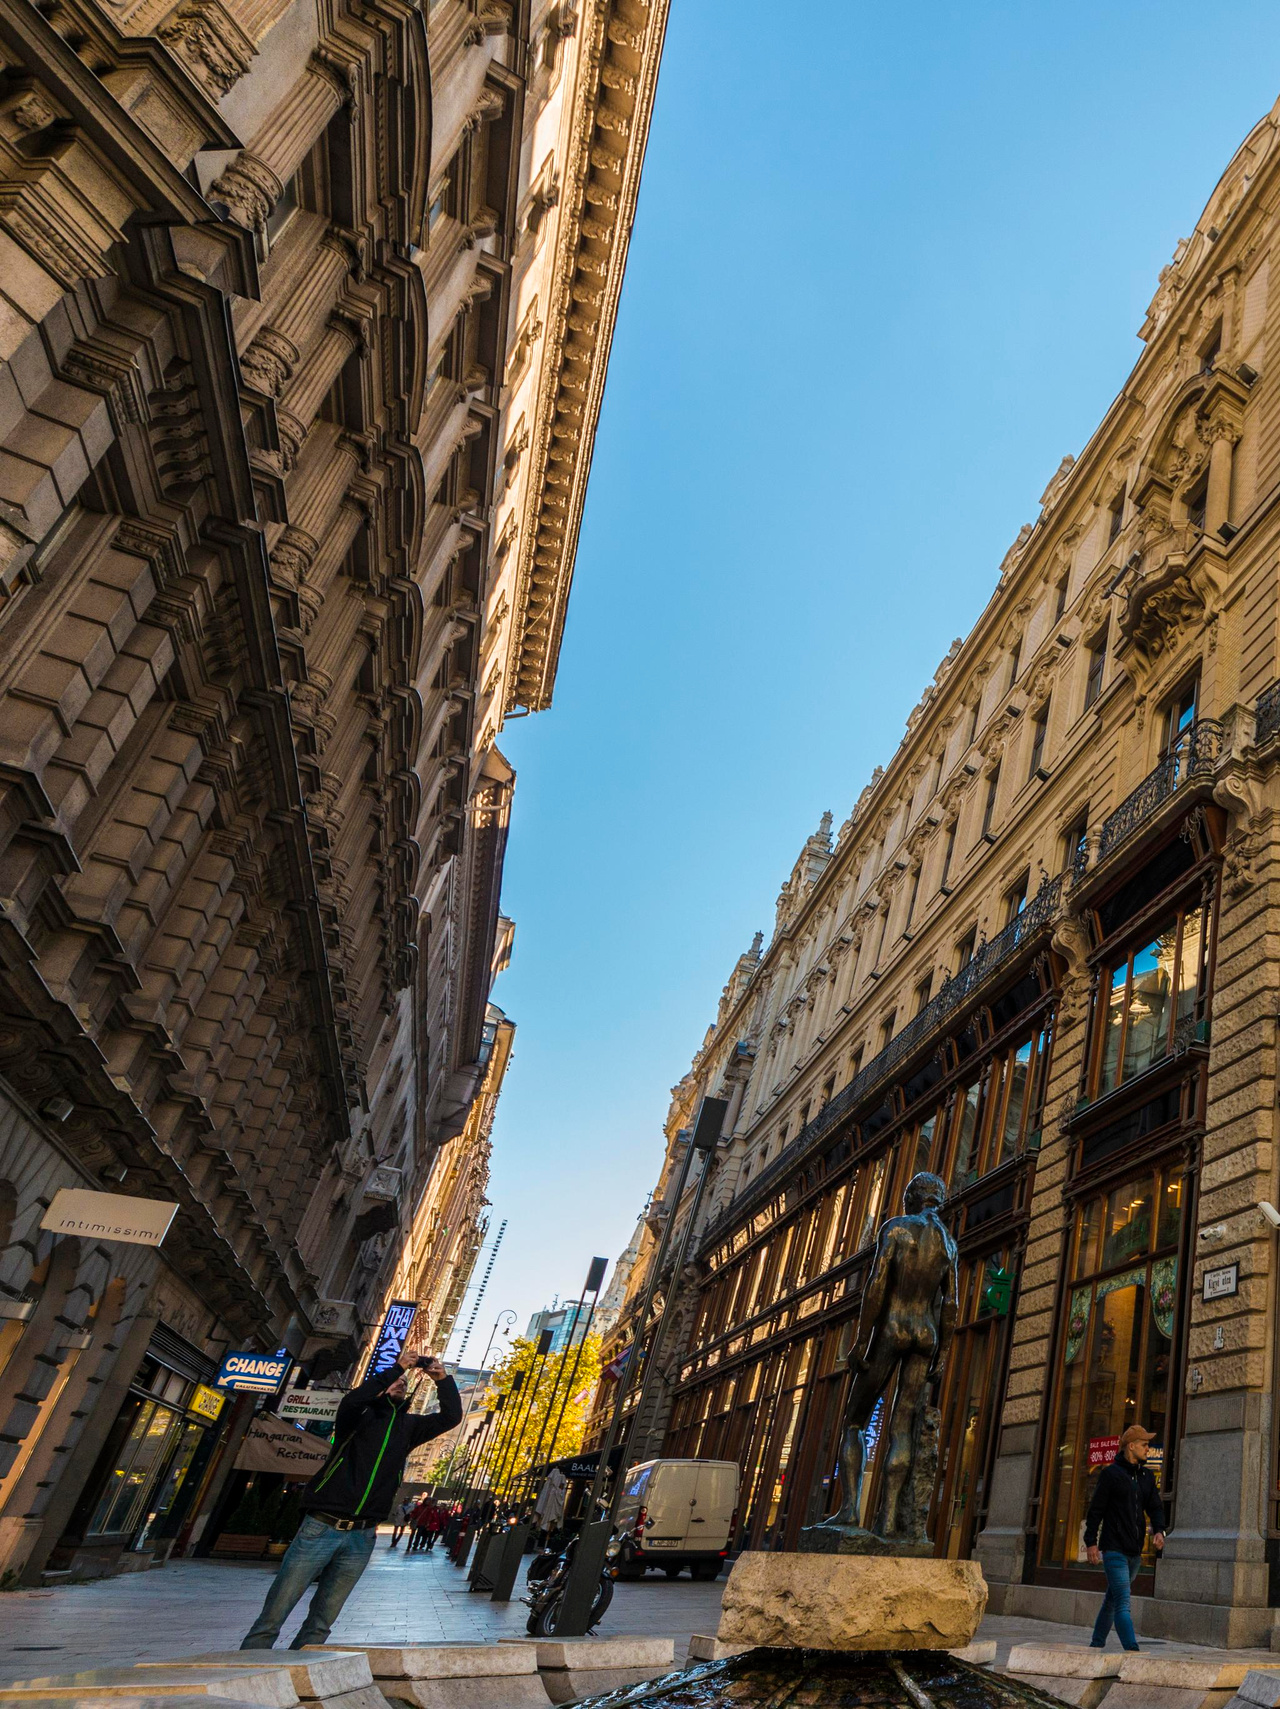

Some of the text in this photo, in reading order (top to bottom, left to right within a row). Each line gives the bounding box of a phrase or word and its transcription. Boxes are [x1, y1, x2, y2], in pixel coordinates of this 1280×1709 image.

[226, 1357, 285, 1377] CHANGE
[287, 1394, 310, 1405] GRILL
[282, 1405, 336, 1417] RESTAURANT
[248, 1429, 303, 1443] Hungarian
[1100, 1440, 1110, 1448] SALE
[276, 1447, 327, 1461] Restaura
[571, 1462, 598, 1473] BAAL
